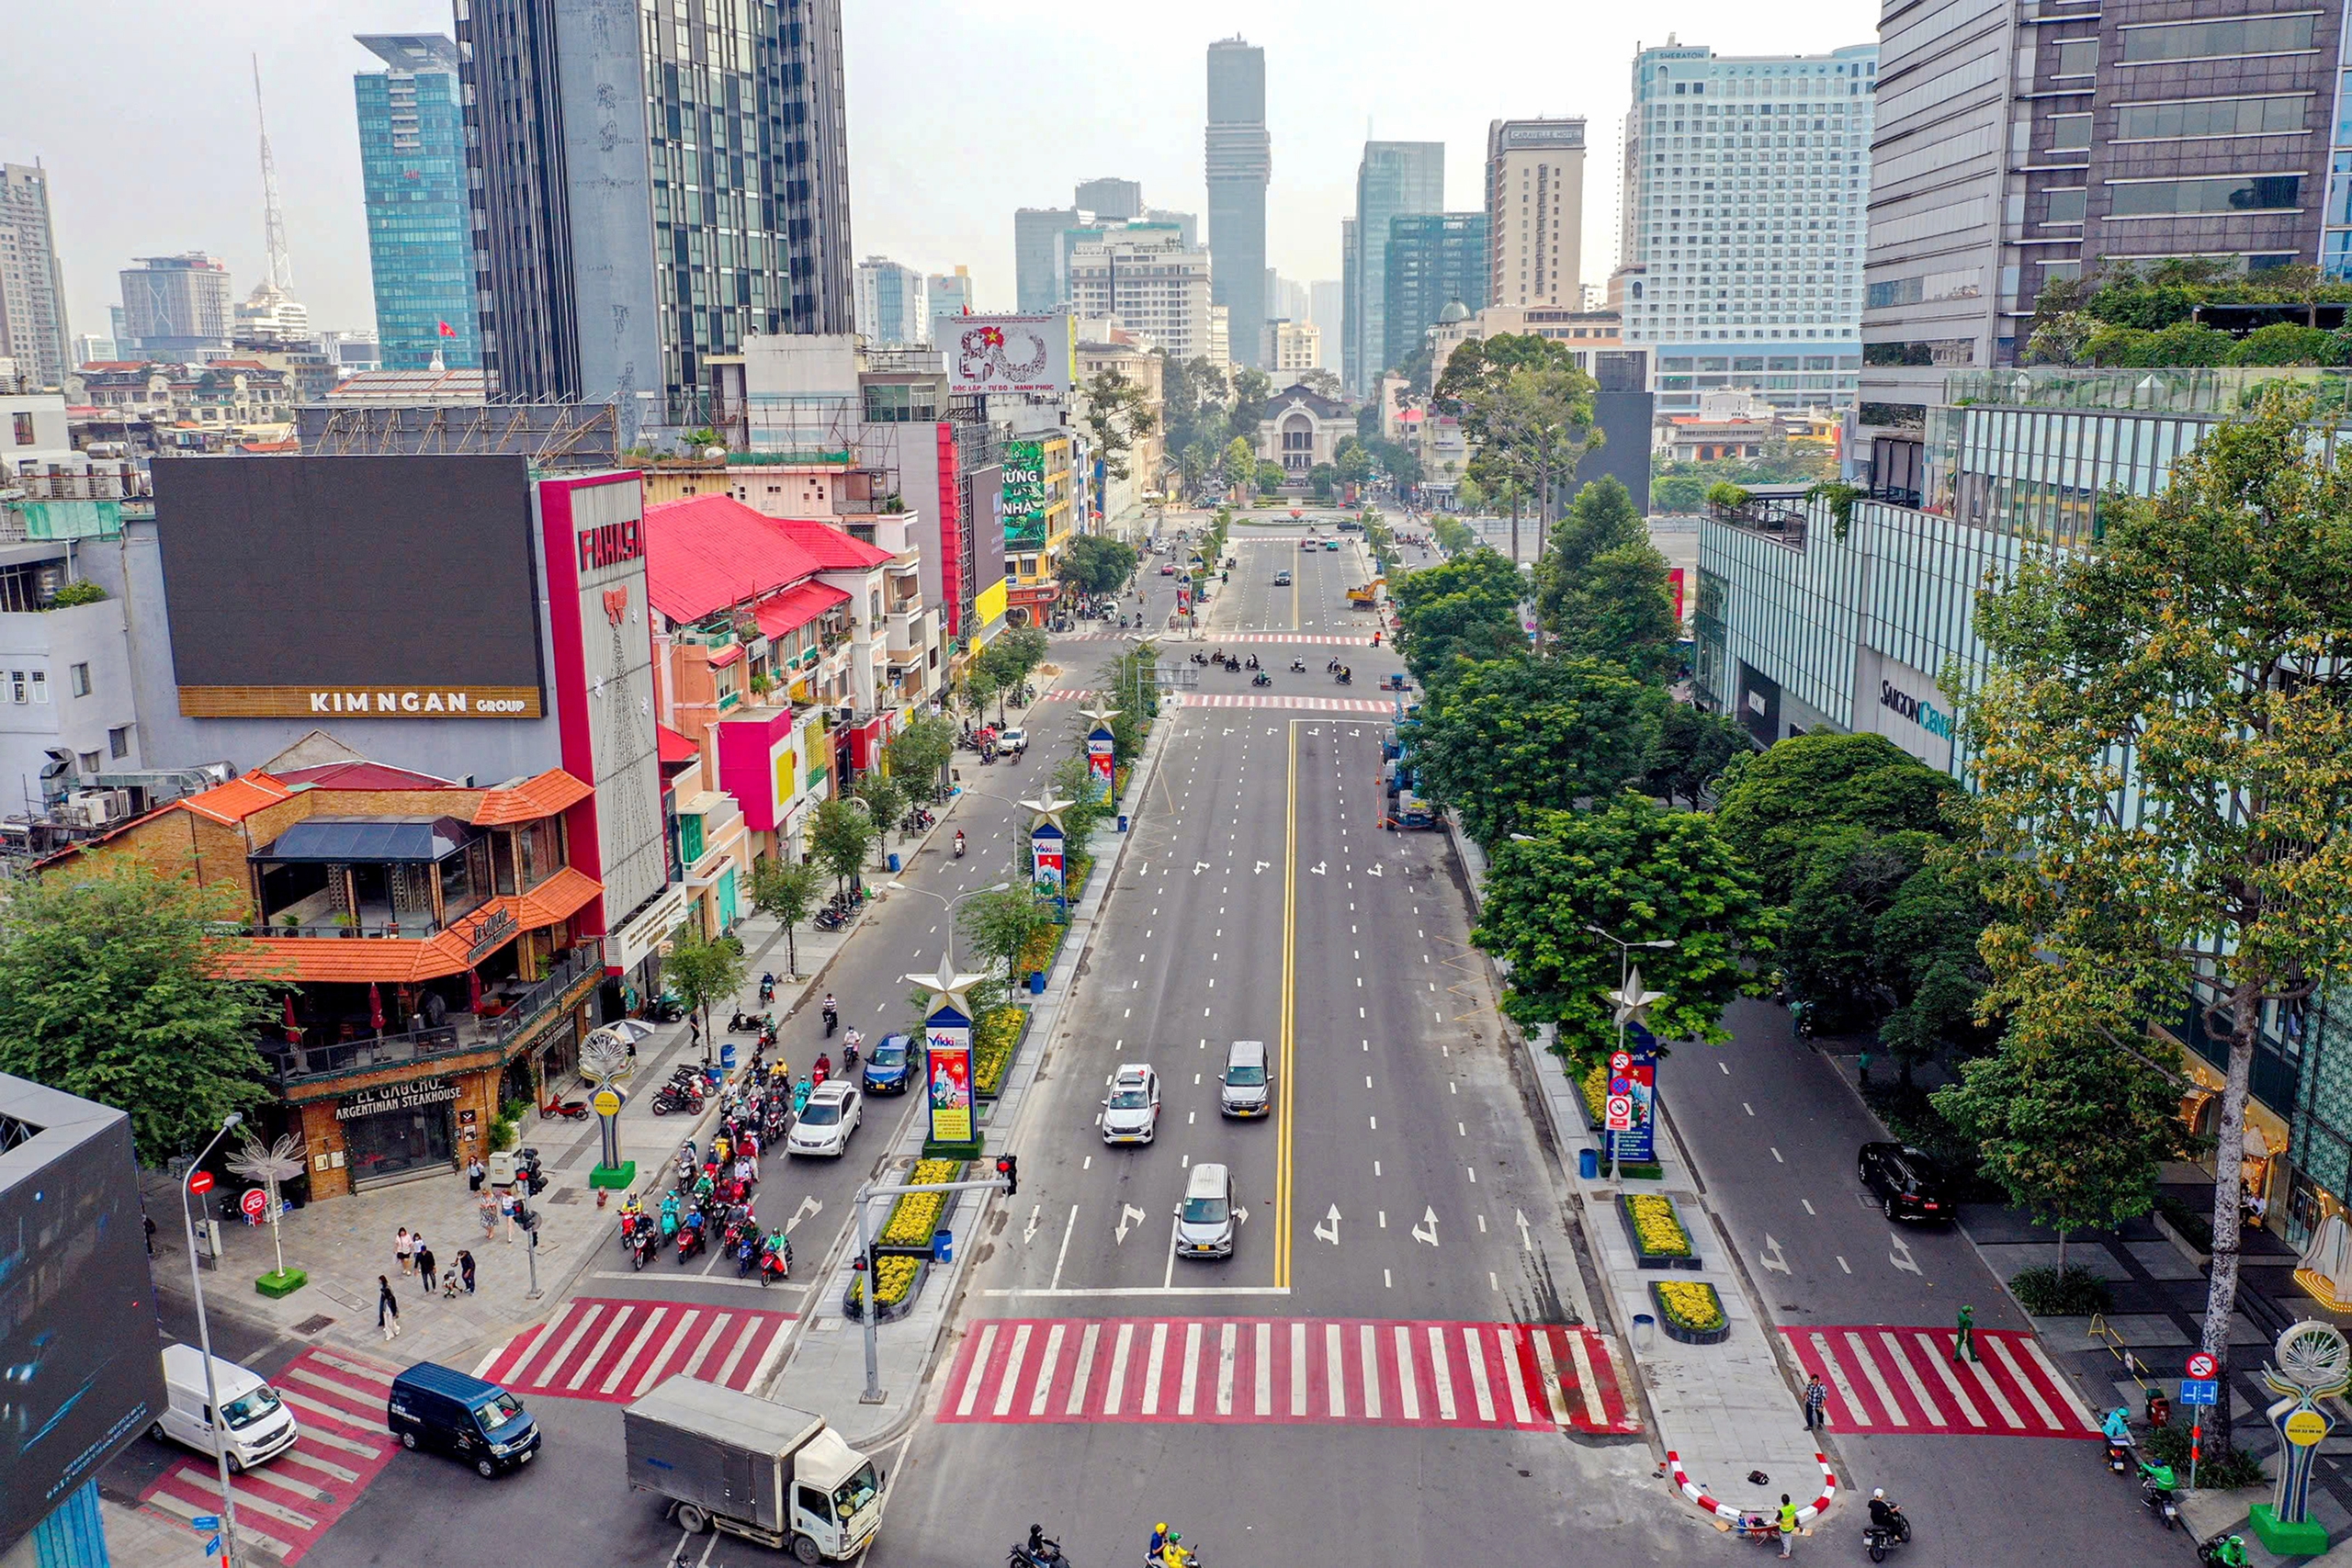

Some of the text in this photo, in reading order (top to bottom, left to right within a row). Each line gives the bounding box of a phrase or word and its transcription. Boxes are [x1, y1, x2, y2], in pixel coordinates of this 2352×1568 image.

[1002, 499, 1034, 515] NHÀ
[578, 519, 645, 572] FAHASA
[311, 692, 526, 713] KIM NGAN GROUP
[928, 1032, 955, 1046] Vikki
[335, 1087, 462, 1121] ARGENTINIAN STEAKHOUSE
